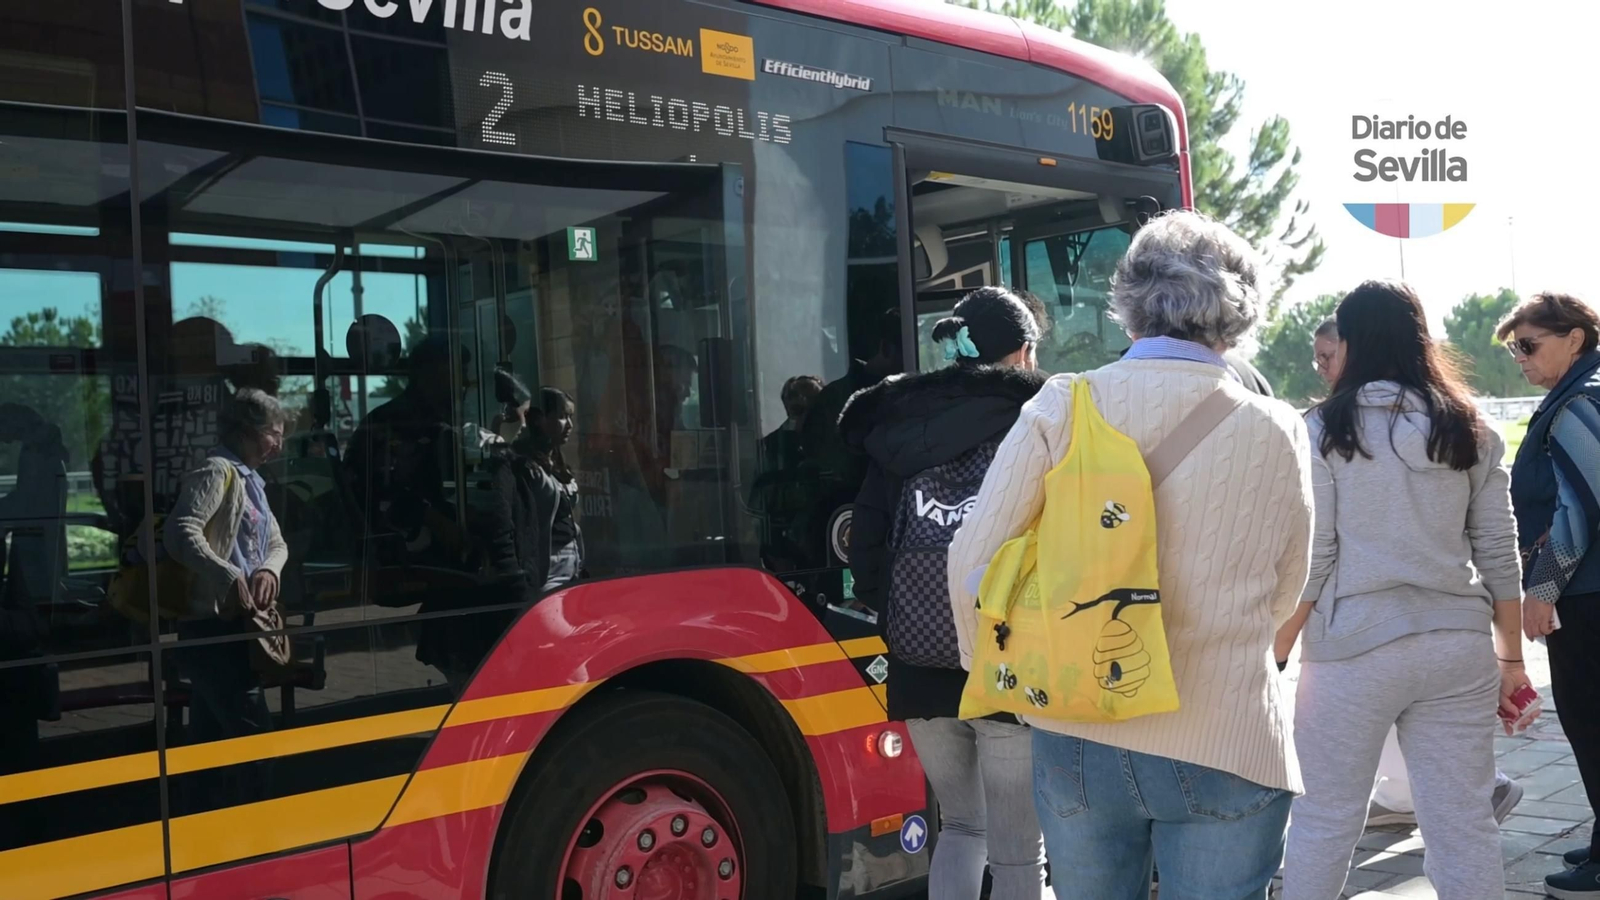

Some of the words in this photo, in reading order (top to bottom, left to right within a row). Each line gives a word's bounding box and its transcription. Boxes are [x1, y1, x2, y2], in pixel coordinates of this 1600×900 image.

[317, 0, 532, 41] villa
[612, 26, 693, 57] TUSSAM
[479, 71, 516, 146] 2
[578, 85, 792, 144] HELIOPOLIS
[937, 87, 1002, 116] MAN
[1067, 101, 1113, 141] 1159
[1131, 592, 1157, 601] Normal
